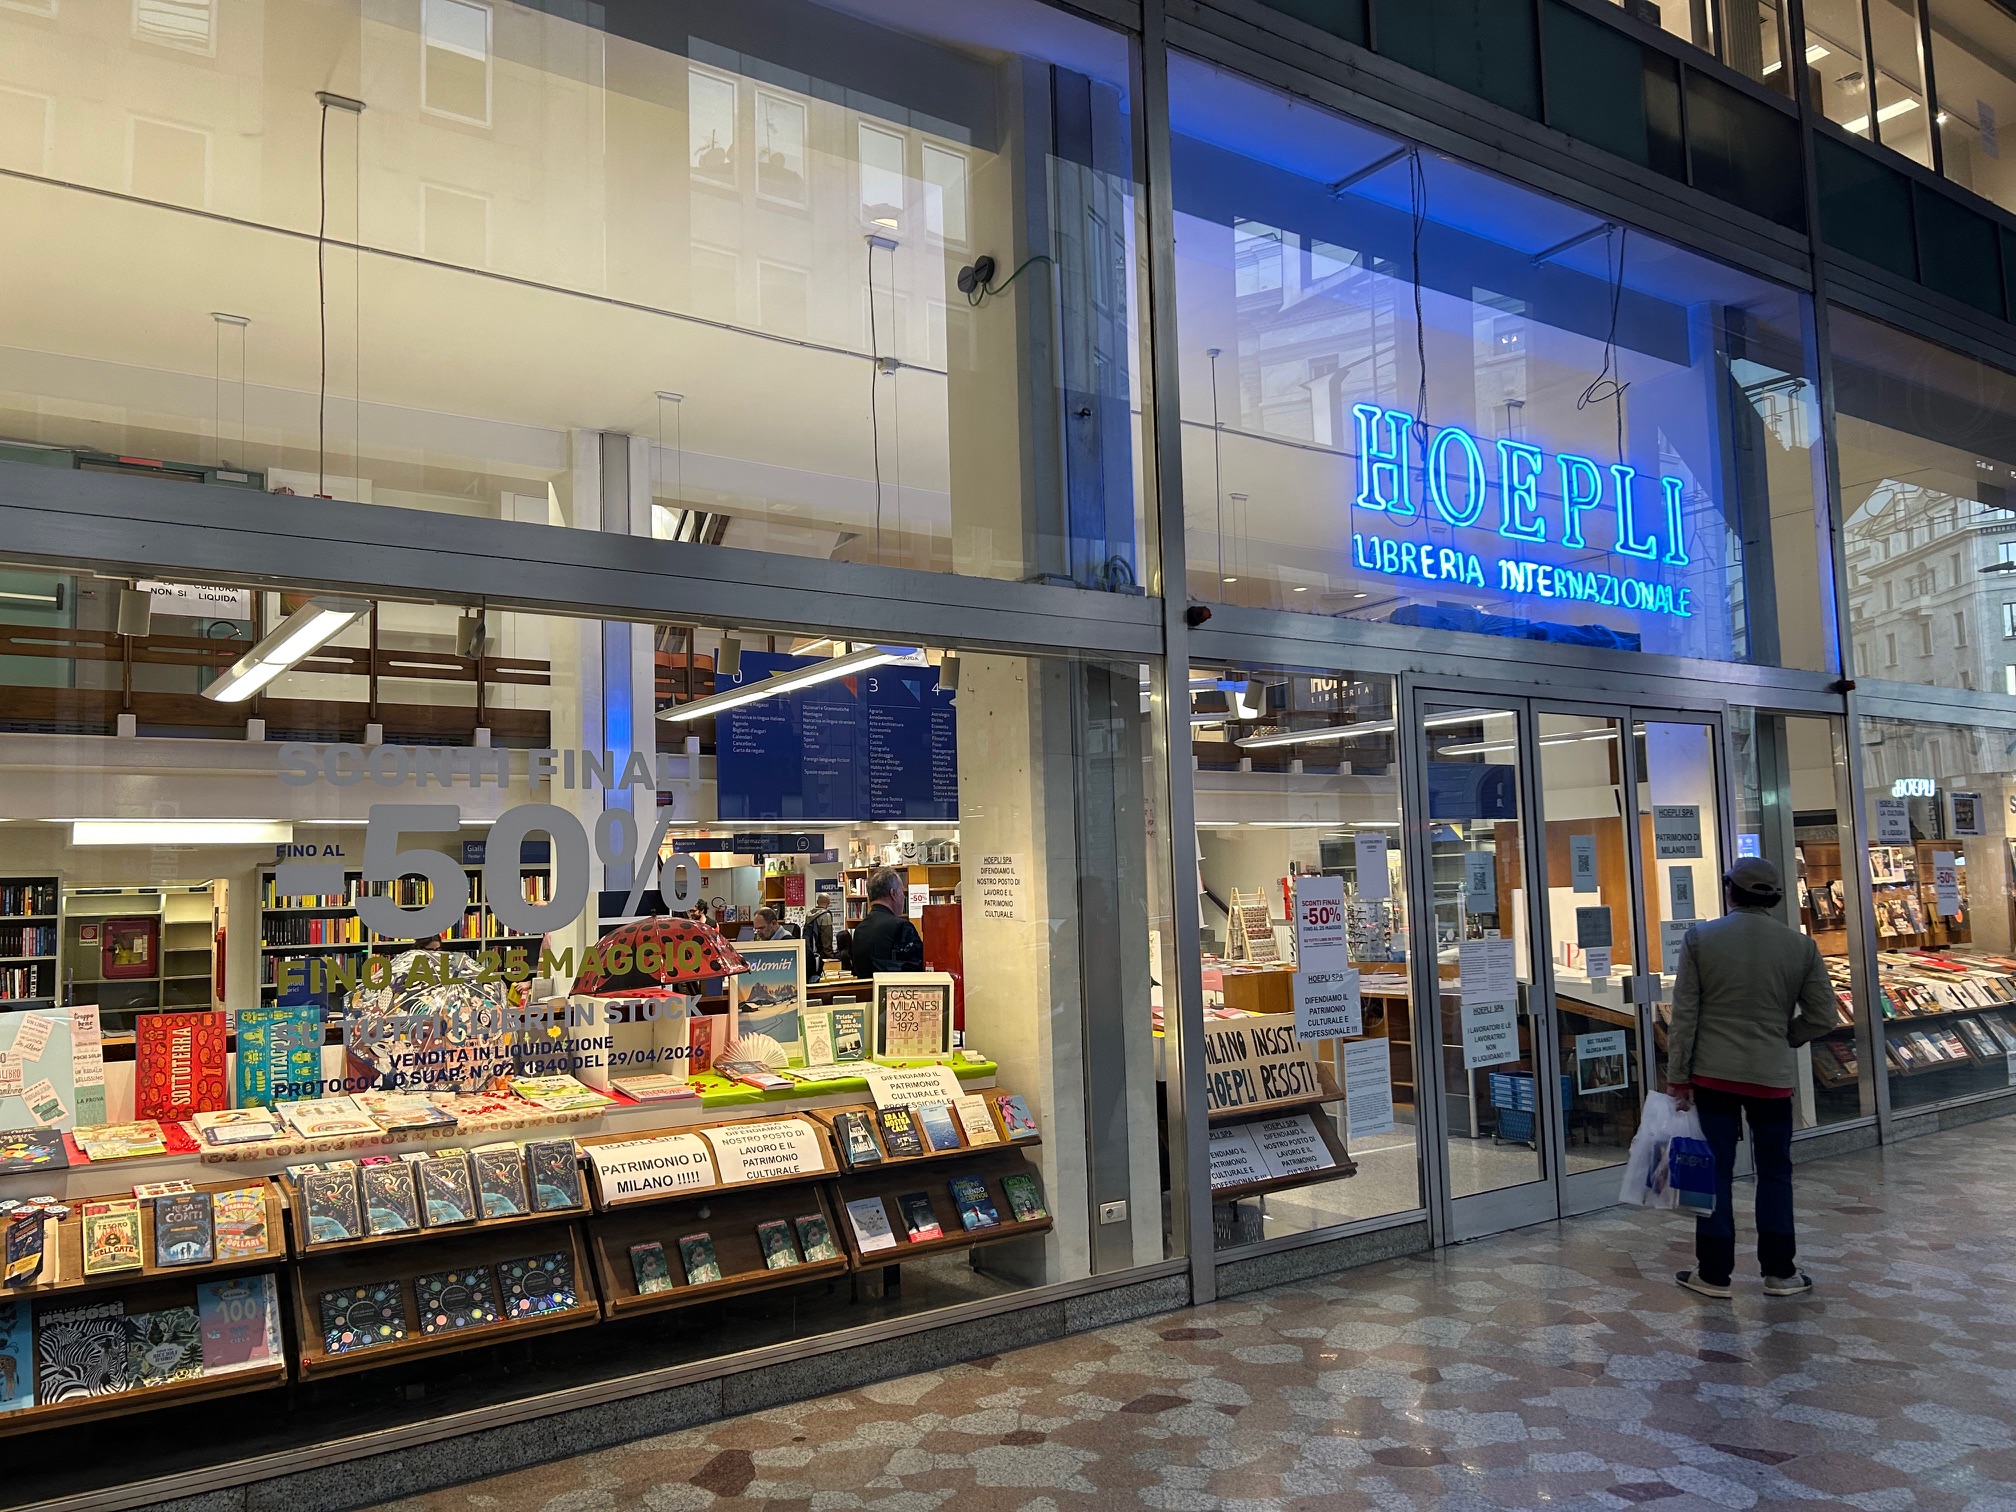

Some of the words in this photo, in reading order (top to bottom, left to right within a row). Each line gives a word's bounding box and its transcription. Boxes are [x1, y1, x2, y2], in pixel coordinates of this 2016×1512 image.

[1353, 403, 1690, 566] HOEPLI
[1353, 533, 1485, 588] LIBRERIA
[1499, 559, 1692, 618] INTERNAZIONALE
[150, 587, 172, 596] NON
[177, 589, 187, 597] SI
[198, 593, 237, 602] LIQUIDA
[868, 677, 879, 692] 3
[931, 682, 940, 696] 4
[1311, 686, 1369, 703] LIBRERIA
[276, 743, 509, 788] SCONTI
[528, 748, 700, 791] FINALI
[1658, 808, 1681, 817] HOEPLI
[1681, 808, 1694, 817] SPA
[736, 836, 770, 845] Informazioni
[1656, 833, 1693, 842] PATRIMONIO
[1693, 833, 1700, 841] DI
[276, 844, 317, 857] FINO
[323, 844, 345, 857] AL
[1661, 845, 1685, 854] MILANO
[983, 856, 1002, 864] HOEPLI
[1003, 856, 1012, 864] SPA
[276, 803, 701, 939] -50%
[997, 878, 1014, 886] POSTO
[1015, 878, 1020, 886] DI
[984, 899, 1014, 907] PATRIMONIO
[984, 910, 1014, 919] CULTURALE
[1302, 906, 1341, 925] -50%
[277, 956, 392, 996] FINO
[405, 953, 465, 989] AL
[476, 949, 530, 983] 25
[543, 940, 701, 979] MAGGIO
[1308, 974, 1331, 983] HOEPLI
[1331, 973, 1344, 982] SPA
[890, 989, 919, 1000] CASE
[1304, 993, 1343, 1005] DIFENDIAMO
[1343, 993, 1349, 1001] IL
[890, 1001, 940, 1012] MILANESI
[1309, 1004, 1346, 1015] PATRIMONIO
[1472, 1006, 1492, 1015] HOEPLI
[1494, 1004, 1504, 1012] SPA
[275, 1022, 325, 1051] SU
[335, 1012, 441, 1046] TUTTI
[471, 1006, 555, 1035] LIBRI
[564, 1003, 594, 1027] IN
[603, 994, 703, 1025] STOCK
[891, 1011, 915, 1022] 1923
[1307, 1016, 1344, 1027] CULTURALE
[1344, 1015, 1349, 1023] E
[1300, 1026, 1351, 1039] PROFESSIONALE
[1470, 1023, 1501, 1034] LAVORATORI
[1505, 1021, 1512, 1029] LE
[1474, 1032, 1506, 1043] LAVORATRICI
[390, 1047, 468, 1070] VENDITA
[474, 1047, 490, 1061] IN
[494, 1035, 614, 1058] LIQUIDAZIONE
[1485, 1043, 1497, 1051] NON
[1477, 1052, 1504, 1062] LIQUIDANO
[171, 1026, 193, 1107] SOTTOTERRA
[275, 1073, 406, 1098] PROTOCOLLO
[471, 1064, 489, 1079] N°
[493, 1058, 568, 1076] 0271840
[574, 1055, 604, 1070] DEL
[608, 1044, 705, 1067] 29/04/2026
[881, 1071, 932, 1082] DIFENDIAMO
[933, 1070, 941, 1078] IL
[890, 1079, 940, 1090] PATRIMONIO
[1206, 1068, 1259, 1110] HOEPLI
[1259, 1060, 1316, 1100] RESISTI
[891, 1089, 941, 1100] CULTURALE
[942, 1088, 948, 1096] E
[883, 1113, 898, 1121] ERA
[897, 1111, 907, 1119] LA
[884, 1118, 911, 1128] NOSTRA
[890, 1124, 909, 1134] CASA
[1262, 1122, 1286, 1131] HOEPLI
[1286, 1119, 1299, 1128] SPA
[725, 1125, 782, 1136] DIFENDIAMO
[1221, 1130, 1234, 1138] SPA
[1263, 1129, 1301, 1140] DIFENDIAMO
[722, 1135, 761, 1146] NOSTRO
[762, 1130, 794, 1140] POSTO
[795, 1129, 805, 1137] DI
[739, 1143, 777, 1155] LAVORO
[779, 1142, 786, 1150] E
[787, 1141, 796, 1149] IL
[1263, 1140, 1289, 1151] NOSTRO
[1289, 1137, 1309, 1146] POSTO
[1276, 1148, 1301, 1158] LAVORO
[600, 1154, 690, 1176] PATRIMONIO
[692, 1152, 708, 1164] DI
[742, 1153, 799, 1167] PATRIMONIO
[1209, 1157, 1248, 1170] PATRIMONIO
[1281, 1155, 1317, 1167] PATRIMONIO
[1675, 1153, 1711, 1168] HOEPLI
[746, 1164, 800, 1180] CULTURALE
[1211, 1167, 1249, 1180] CULTURALE
[617, 1174, 674, 1193] MILANO
[677, 1171, 700, 1185] !!!!!
[172, 1203, 194, 1213] RESA
[165, 1211, 203, 1223] CONTI
[97, 1221, 128, 1231] TESORO
[226, 1239, 260, 1248] DOLLARI
[93, 1246, 113, 1258] HELL
[39, 1302, 124, 1327] nascosti
[215, 1297, 257, 1323] 100
